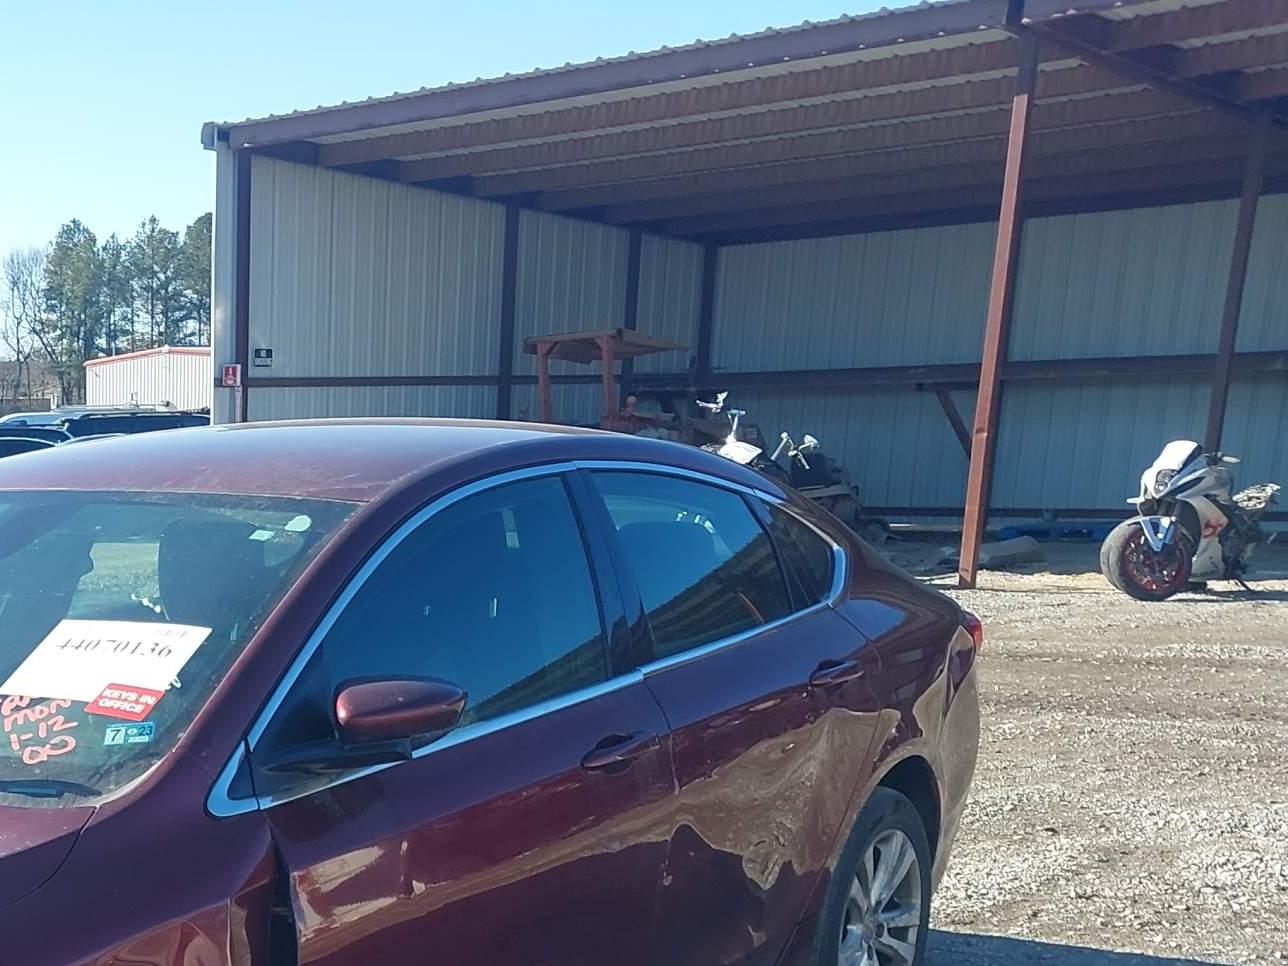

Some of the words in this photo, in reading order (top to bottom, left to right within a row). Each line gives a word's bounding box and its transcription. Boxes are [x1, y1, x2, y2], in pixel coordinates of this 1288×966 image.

[55, 637, 173, 658] 44070136
[101, 688, 138, 701] KEYS
[138, 694, 157, 704] IN
[98, 698, 145, 714] OFFICE
[110, 728, 122, 742] 7
[138, 725, 153, 737] 23
